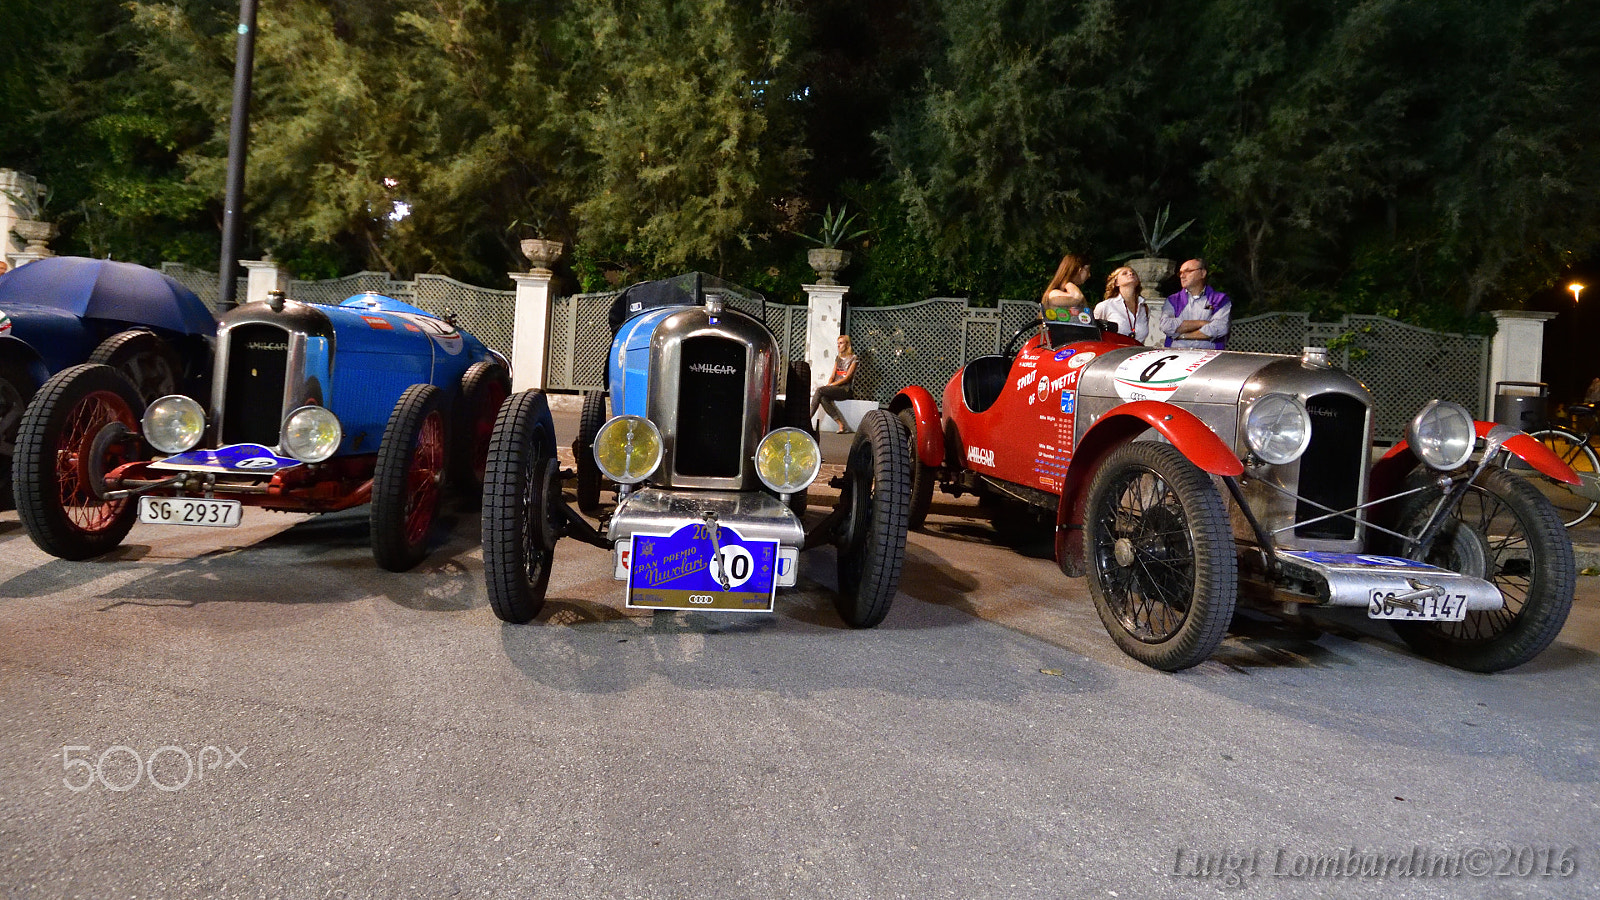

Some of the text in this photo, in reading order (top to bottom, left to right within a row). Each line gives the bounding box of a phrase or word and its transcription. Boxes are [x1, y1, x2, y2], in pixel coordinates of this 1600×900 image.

[690, 363, 736, 375] AMILCAR
[1139, 355, 1180, 382] 6
[1017, 369, 1037, 391] SPIRIT
[1051, 370, 1077, 393] YVETTE
[1028, 393, 1036, 406] OF
[241, 459, 273, 467] 12
[967, 445, 996, 467] AMILCAR
[663, 546, 697, 564] PREMIO
[645, 554, 708, 586] Nuvolari
